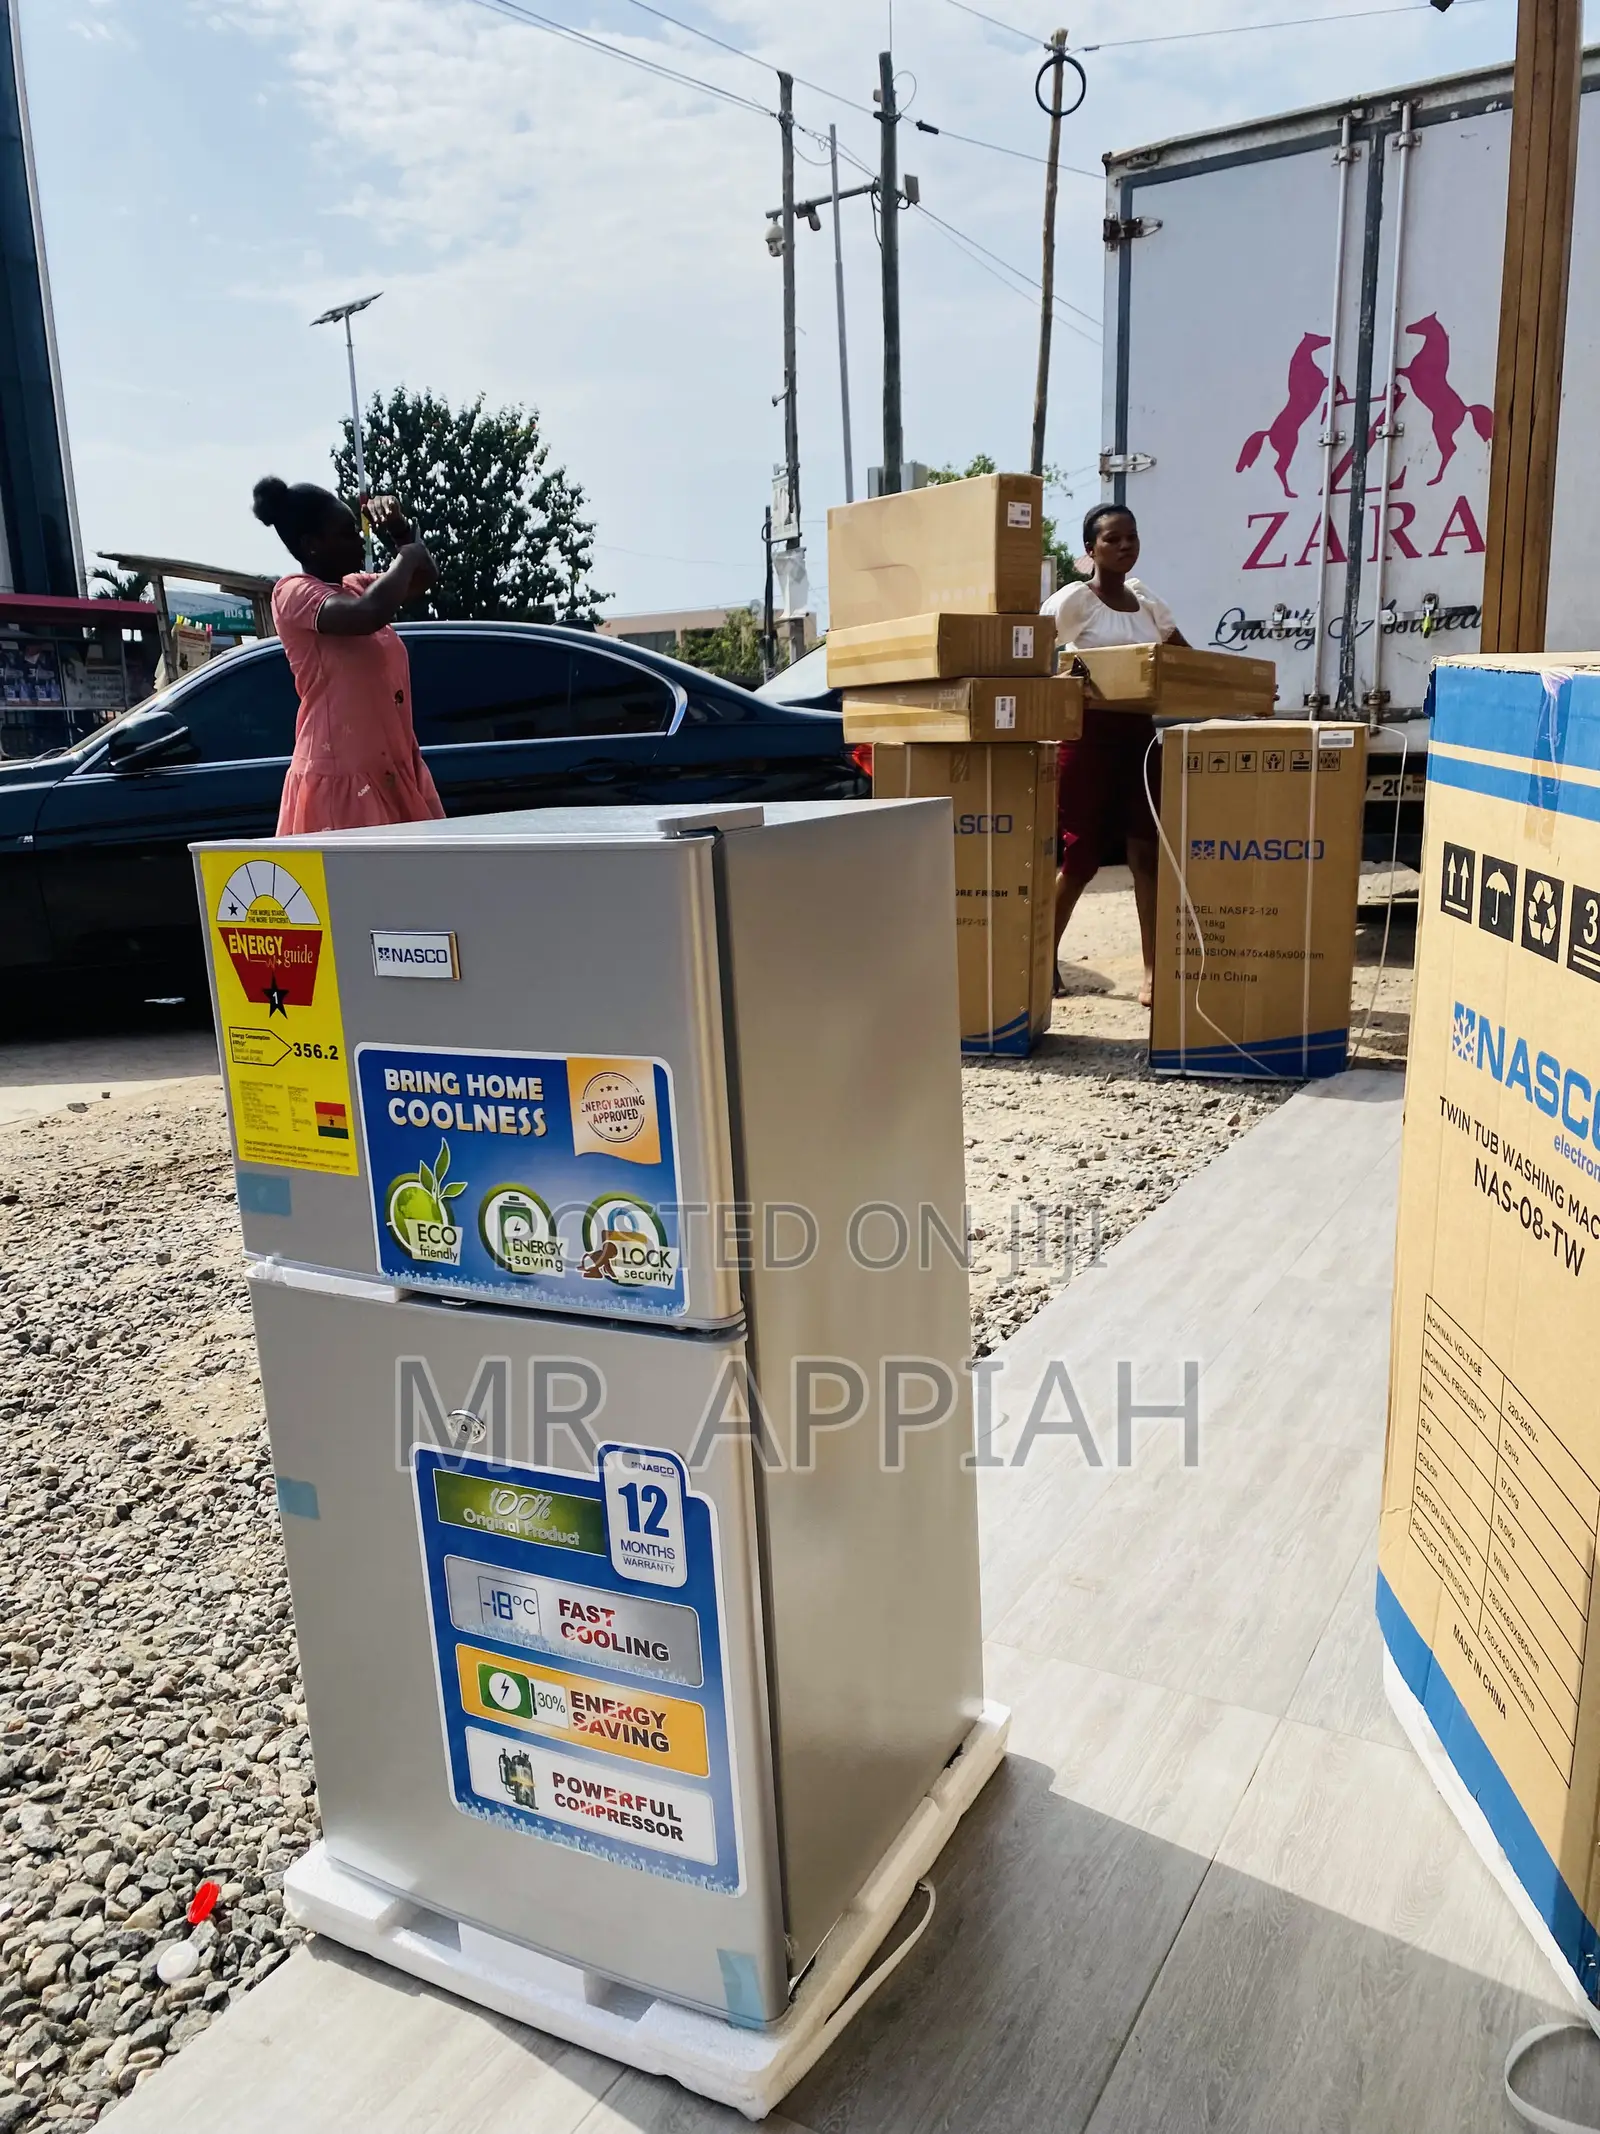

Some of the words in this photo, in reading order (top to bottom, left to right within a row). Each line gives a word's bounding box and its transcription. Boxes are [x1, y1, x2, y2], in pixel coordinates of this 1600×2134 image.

[1242, 495, 1486, 570] ZARA
[953, 814, 1013, 835] SCO
[1219, 839, 1325, 861] NASCO
[1204, 919, 1226, 930] 18kg
[1219, 906, 1279, 916] NASF2-120
[1583, 898, 1599, 945] 3
[228, 928, 283, 961] ENERGY
[284, 944, 313, 968] guide
[391, 947, 448, 964] NASCO
[1175, 970, 1207, 981] Made
[1210, 971, 1220, 981] in
[1223, 970, 1258, 982] China
[272, 991, 279, 1005] 1
[292, 1042, 339, 1061] 356.2
[384, 1068, 461, 1096] BRING
[467, 1073, 545, 1102] HOME
[593, 1108, 639, 1125] APPROVED
[614, 1095, 645, 1109] RATING
[388, 1097, 548, 1138] COOLNESS
[1439, 1095, 1471, 1136] TWIN
[1474, 1119, 1499, 1155] TUB
[1502, 1140, 1565, 1209] WASHING
[1474, 1157, 1586, 1278] NAS-08-TW
[417, 1223, 457, 1247] ECO
[512, 1238, 563, 1257] ENERGY
[419, 1244, 459, 1264] friendly
[515, 1254, 564, 1273] saving
[622, 1246, 673, 1269] LOCK
[624, 1268, 674, 1286] security
[1427, 1312, 1453, 1348] NOMINAL
[1454, 1340, 1482, 1377] VOLTAGE
[1425, 1348, 1451, 1383] NOMINAL
[1451, 1377, 1487, 1422] FREQUENCY
[1418, 1451, 1439, 1480] COLOR
[1504, 1438, 1520, 1466] 50Hz
[638, 1462, 675, 1475] NASCO
[489, 1487, 553, 1520] 100%
[617, 1481, 670, 1538] 12
[463, 1507, 520, 1534] Original
[524, 1519, 580, 1546] Product
[1415, 1485, 1440, 1519] CARTON
[1440, 1515, 1472, 1567] DIMENSIONS
[620, 1538, 676, 1560] MONTHS
[1411, 1516, 1438, 1557] PRODUCT
[1437, 1552, 1470, 1607] DIMENSIONS
[622, 1555, 675, 1574] WARRANTY
[558, 1598, 616, 1628] FAST
[560, 1622, 670, 1663] COOLING
[1453, 1623, 1474, 1665] MADE
[1473, 1657, 1483, 1679] IN
[1482, 1673, 1507, 1720] CHINA
[537, 1691, 566, 1714] 30%
[570, 1690, 667, 1730] ENERGY
[573, 1711, 670, 1753] SAVING
[552, 1771, 682, 1823] POWERFUL
[554, 1793, 685, 1842] COMPRESSOR
